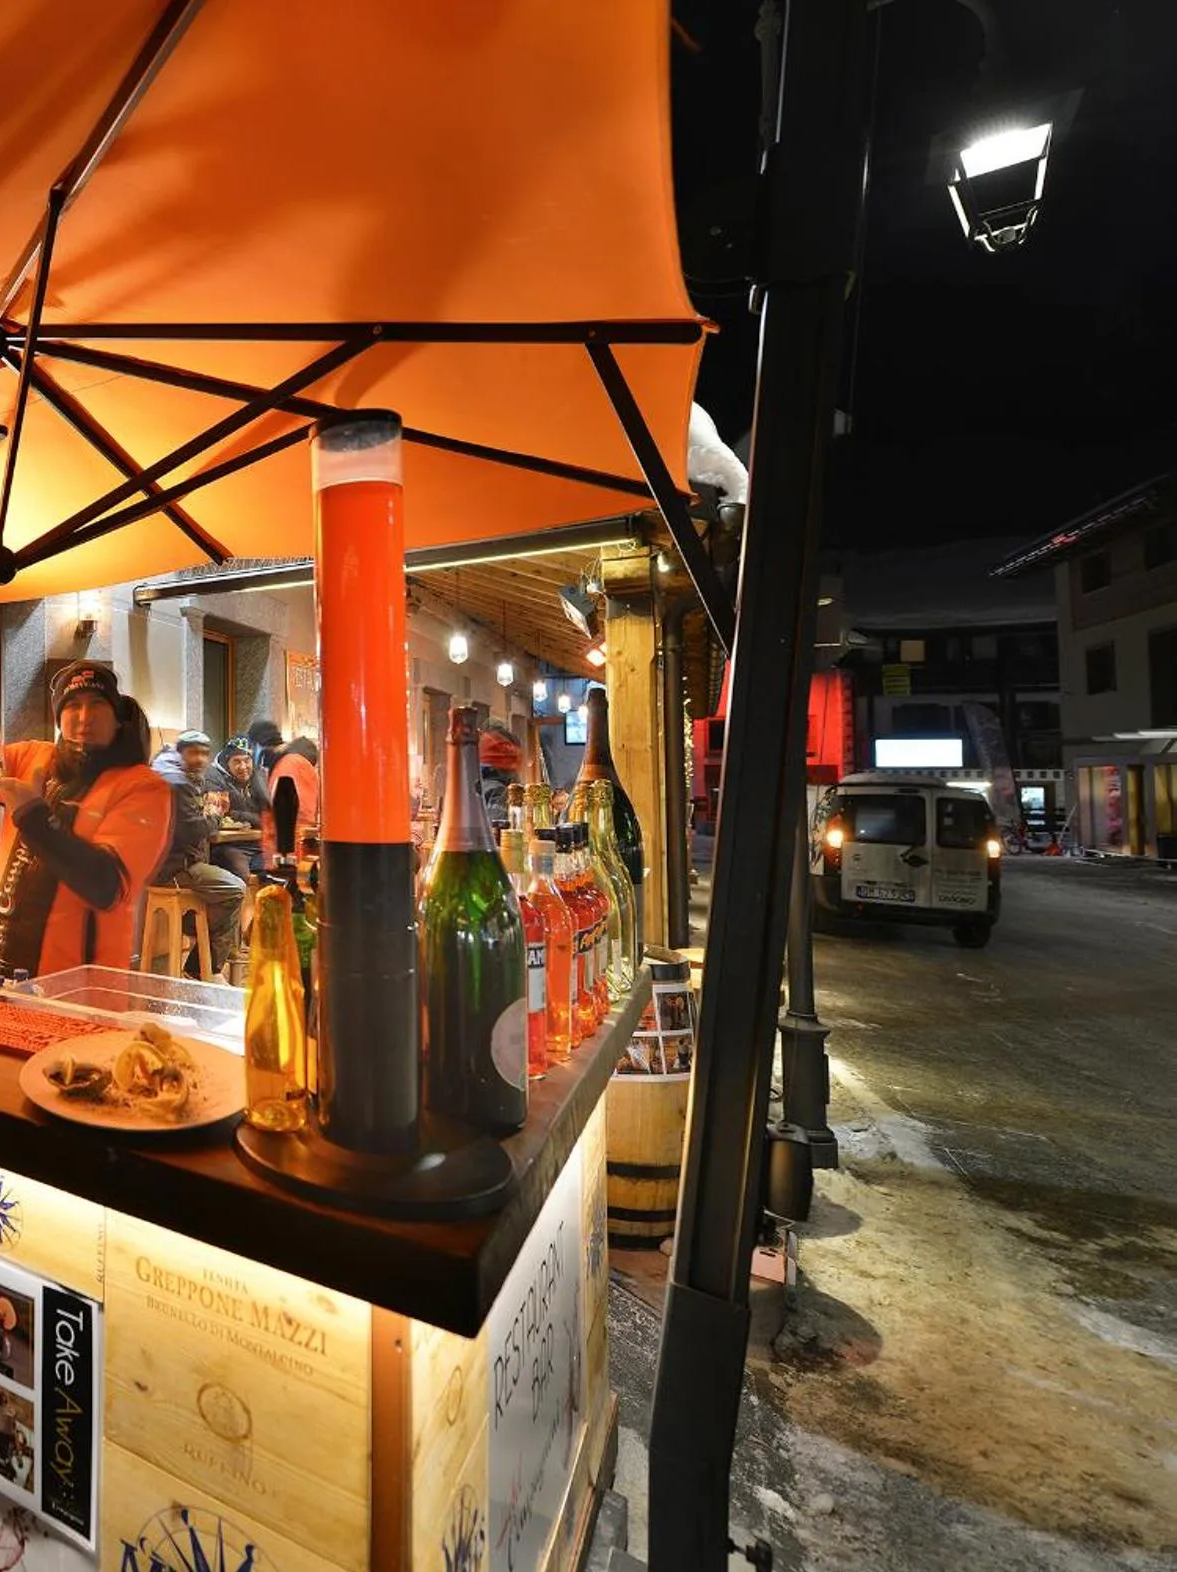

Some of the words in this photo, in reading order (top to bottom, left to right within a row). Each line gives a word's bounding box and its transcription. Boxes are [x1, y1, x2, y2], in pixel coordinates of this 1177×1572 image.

[55, 1309, 83, 1387] Take
[135, 1255, 244, 1323] GREPPONE
[250, 1300, 328, 1357] MAZZI
[146, 1295, 208, 1331] BRUNELLO
[493, 1220, 565, 1431] RESTAURANT
[530, 1322, 554, 1424] BAR
